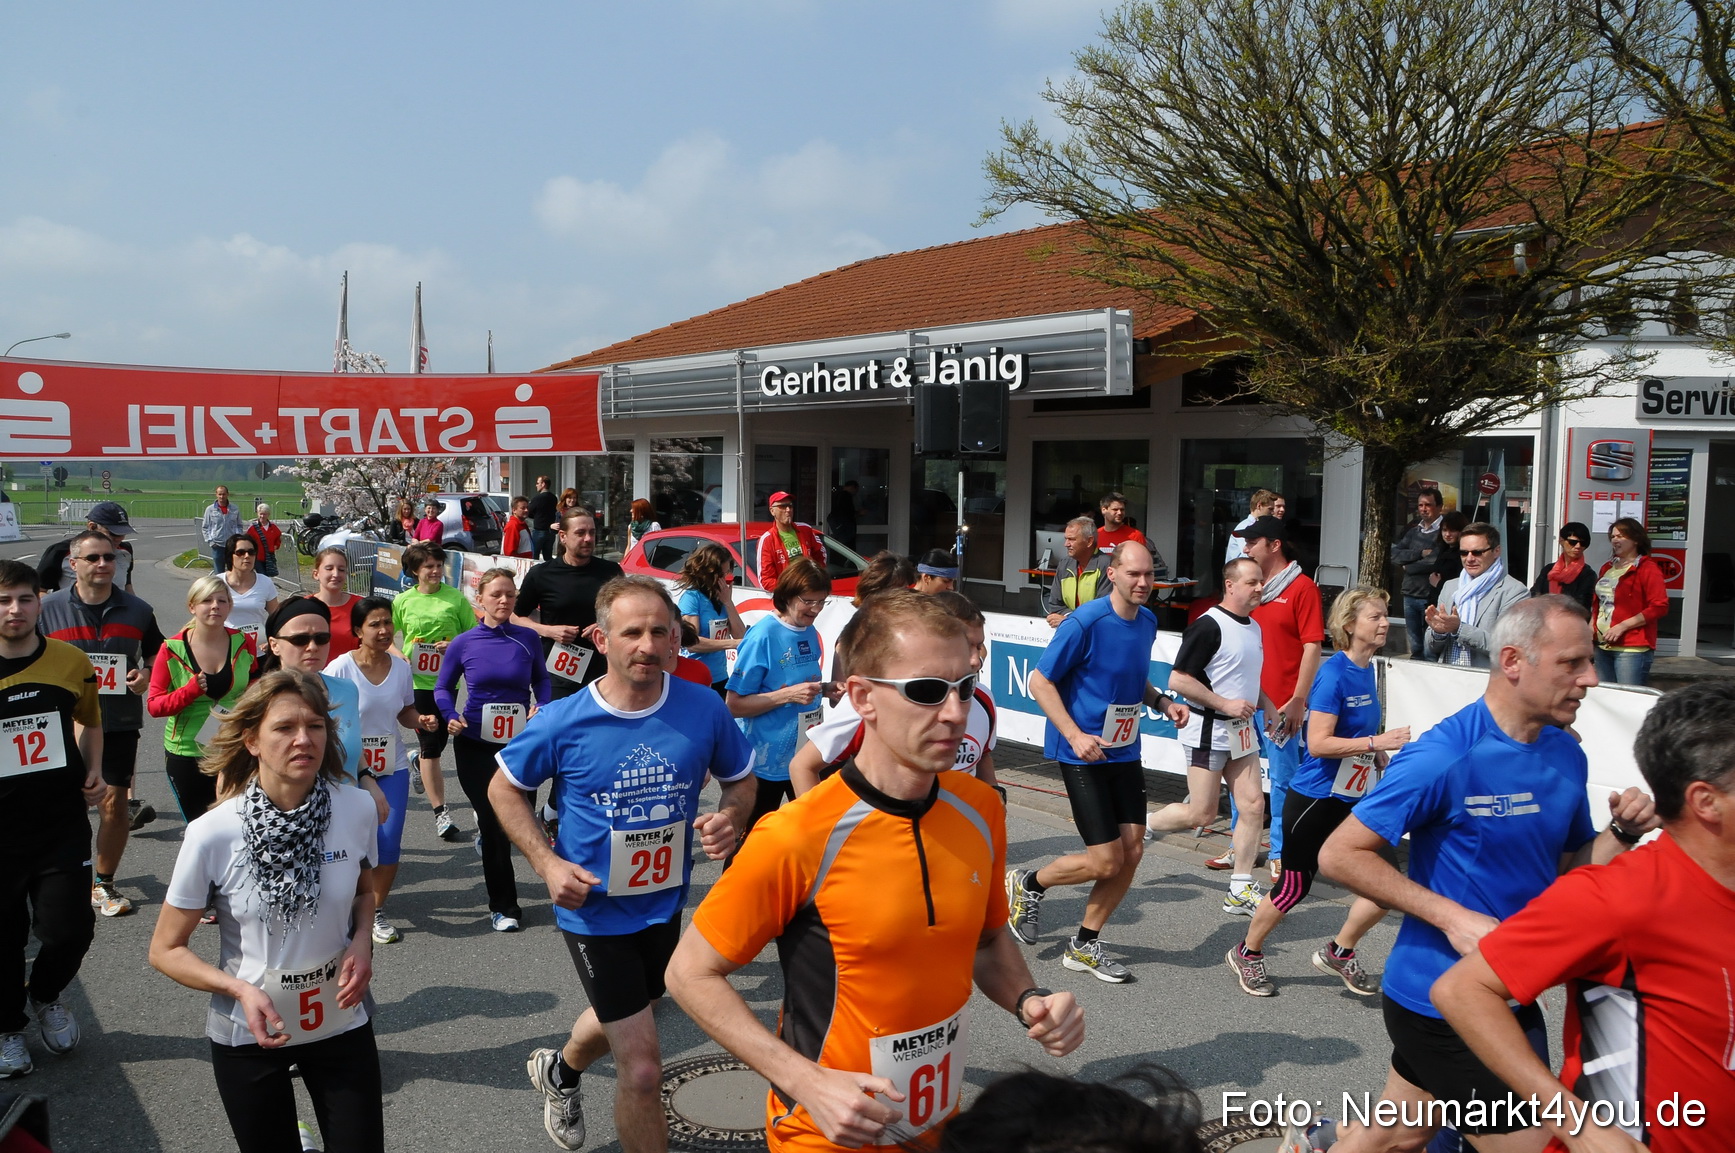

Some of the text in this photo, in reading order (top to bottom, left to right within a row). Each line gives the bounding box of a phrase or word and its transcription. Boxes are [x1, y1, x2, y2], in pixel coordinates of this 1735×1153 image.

[760, 346, 1026, 396] Gerhart & Jänig
[1642, 379, 1735, 415] Servi
[1578, 491, 1640, 501] SEAT
[418, 652, 440, 672] 80
[554, 651, 581, 676] 85
[93, 666, 117, 690] 64
[3, 718, 34, 729] MEYER
[3, 724, 36, 734] WERBUNG
[492, 715, 514, 739] 91
[1112, 717, 1134, 743] 79
[12, 730, 49, 767] 12
[1239, 726, 1251, 752] 18
[1345, 763, 1371, 792] 78
[611, 786, 660, 800] Neumarkter
[625, 831, 661, 843] MEYER
[625, 838, 661, 849] WERBUNG
[628, 845, 672, 888] 29
[281, 969, 323, 984] MEYER
[281, 977, 325, 991] WERBUNG
[300, 987, 324, 1031] 5
[893, 1026, 945, 1053] MEYER
[893, 1038, 945, 1063] WERBUNG
[908, 1050, 951, 1127] 61
